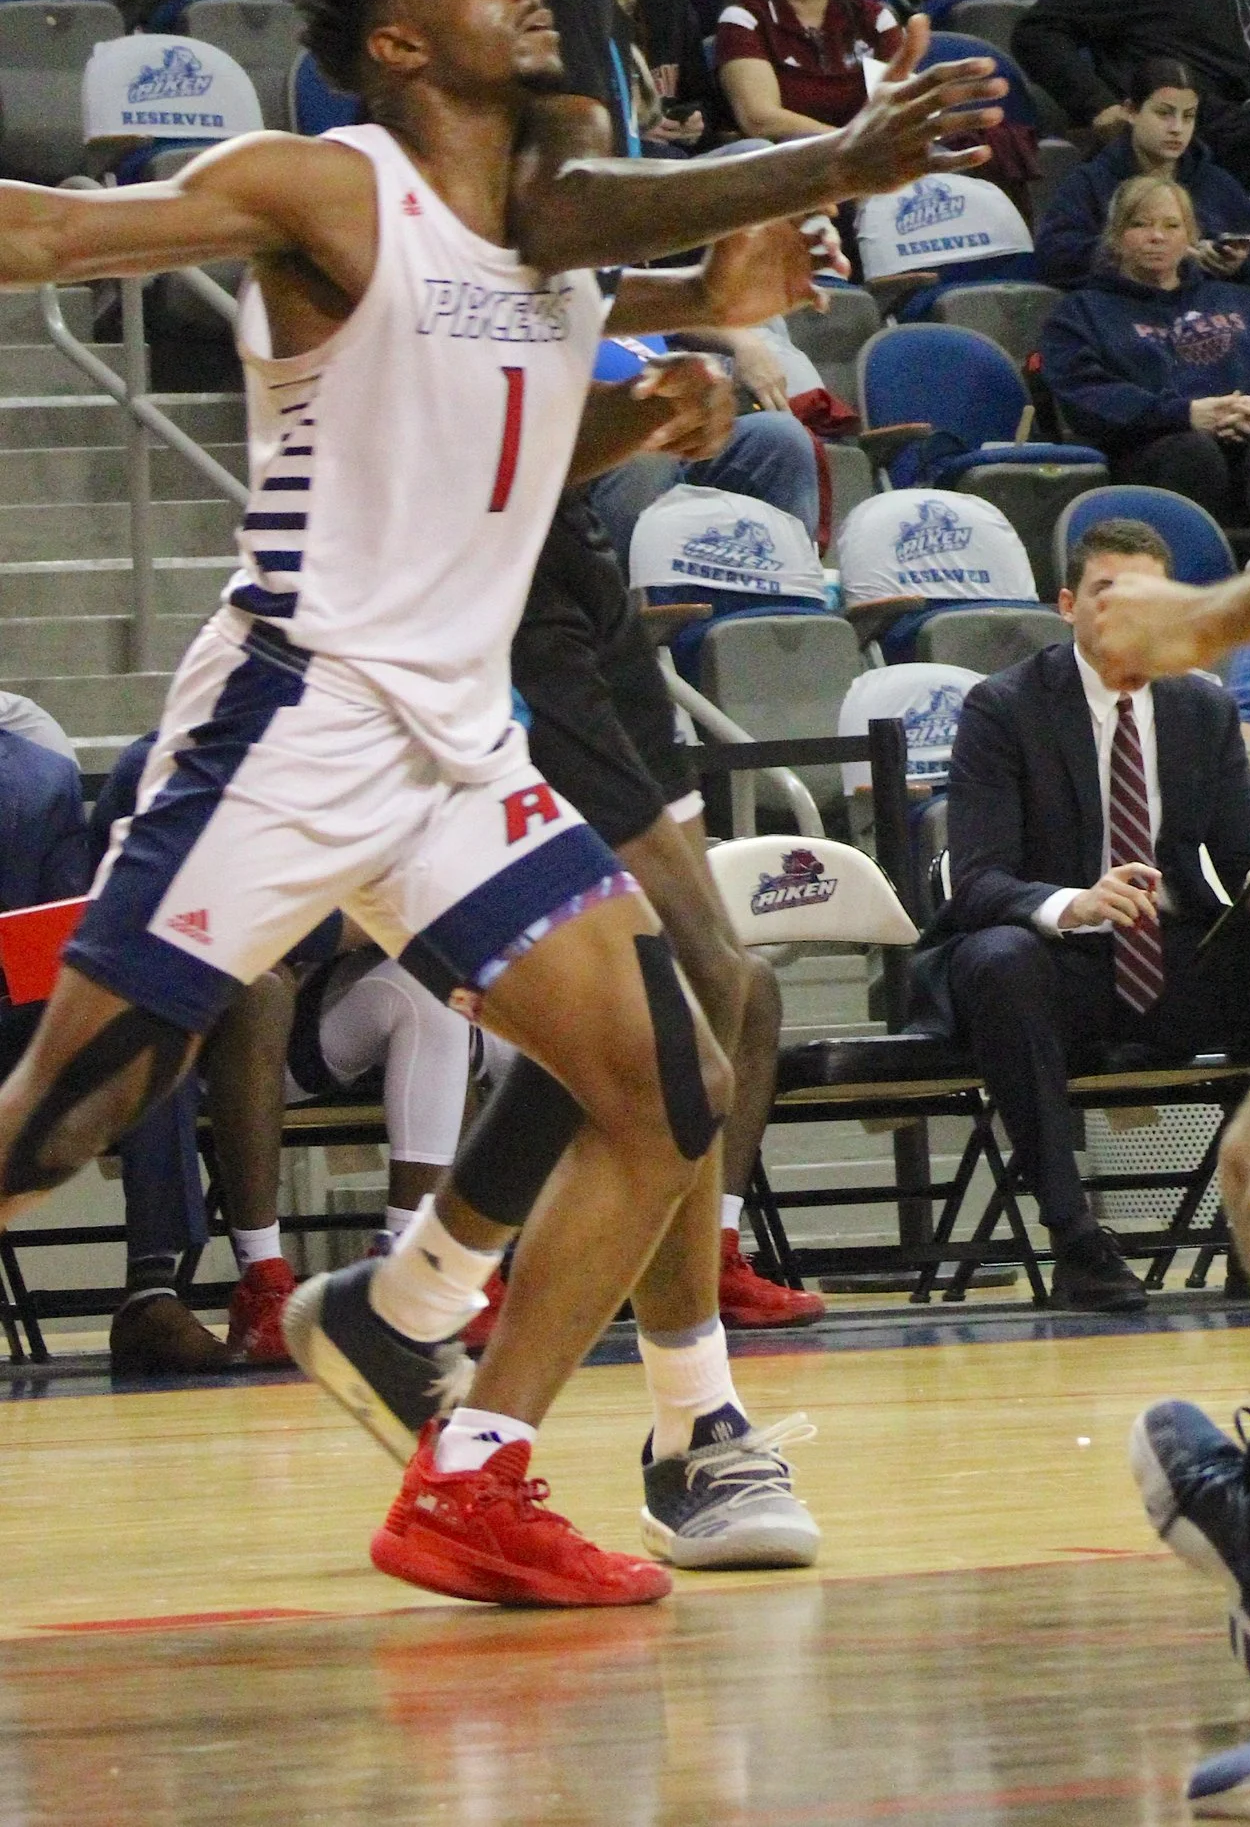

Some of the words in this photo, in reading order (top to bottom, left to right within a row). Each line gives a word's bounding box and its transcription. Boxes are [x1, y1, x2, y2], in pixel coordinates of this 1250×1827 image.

[121, 111, 224, 128] RESERVED
[896, 221, 991, 256] RESERVED
[488, 365, 527, 514] 1
[903, 527, 972, 553] AIKEN
[685, 542, 784, 571] AIKEN
[672, 558, 781, 594] RESERVED
[500, 782, 563, 846] A
[757, 880, 837, 907] AIKEN
